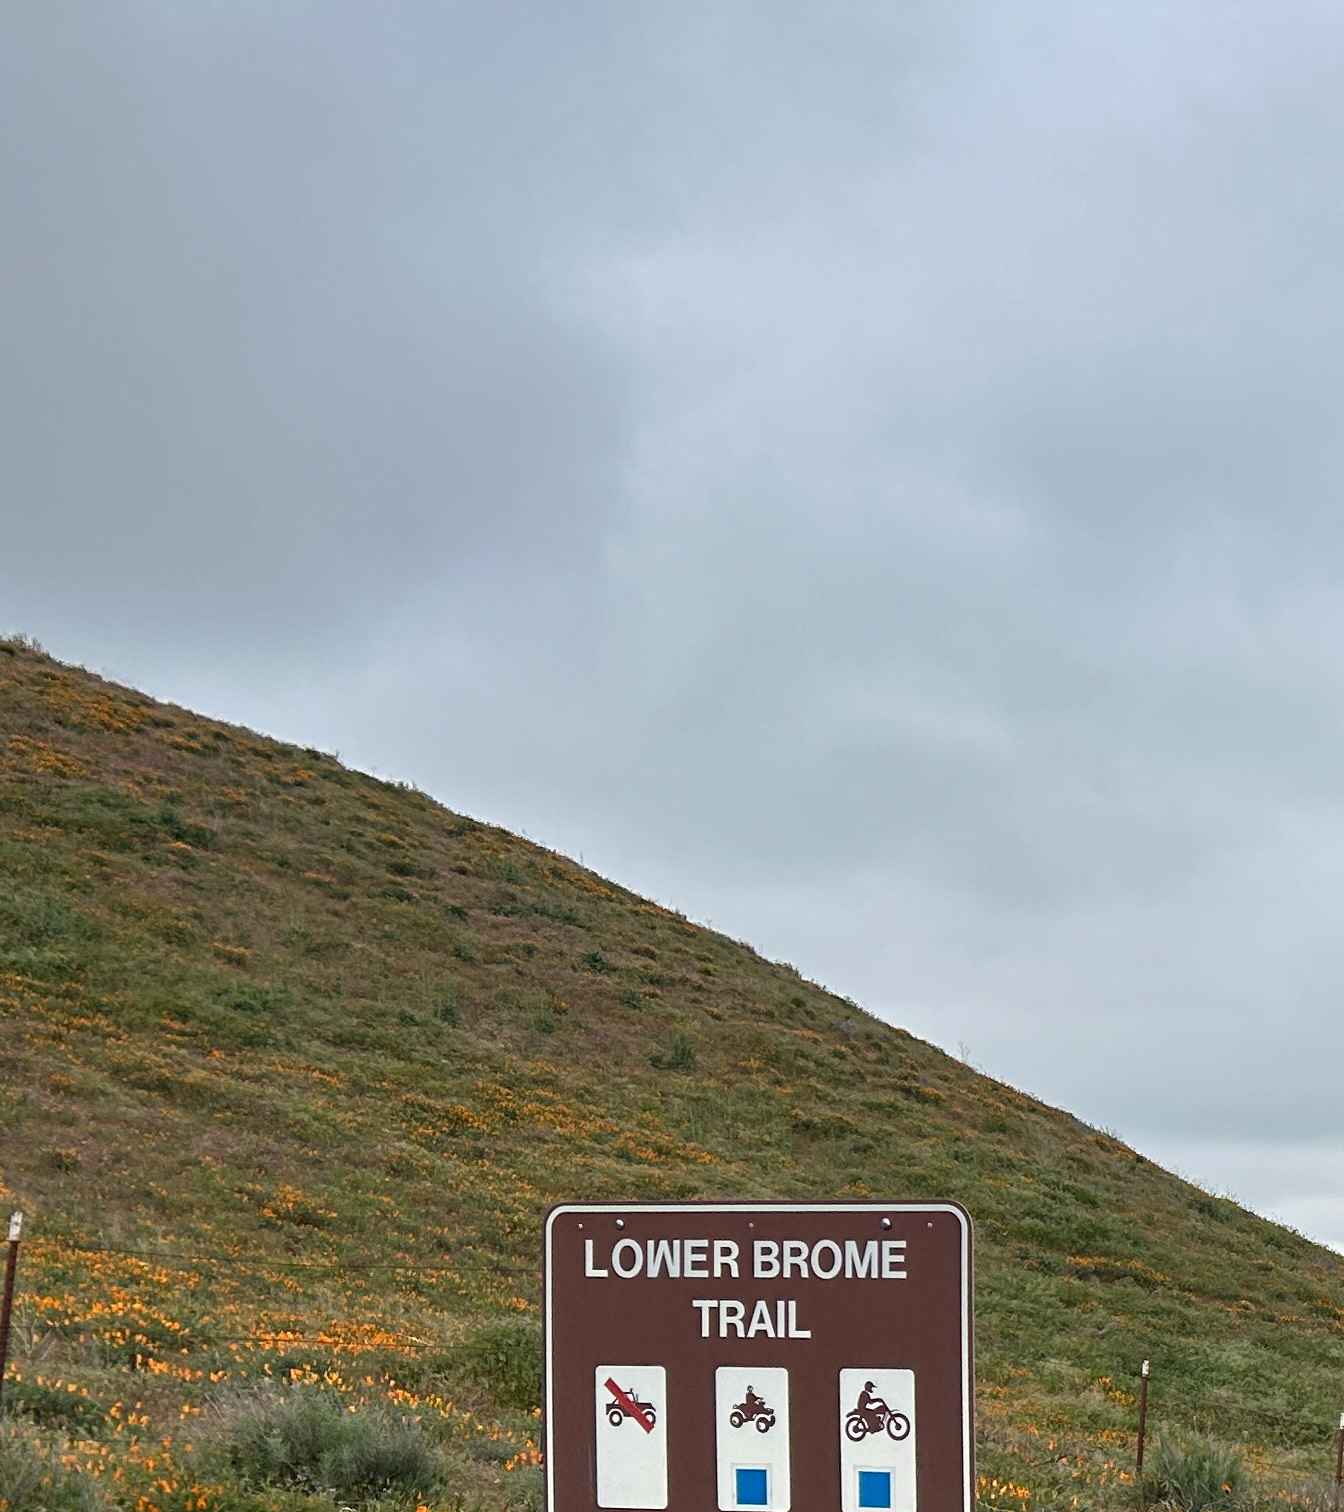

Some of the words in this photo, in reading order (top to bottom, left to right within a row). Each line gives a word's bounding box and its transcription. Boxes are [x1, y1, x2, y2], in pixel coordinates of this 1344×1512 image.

[584, 1238, 740, 1279] LOWER
[752, 1239, 908, 1280] BROME
[691, 1299, 813, 1339] TRAIL
